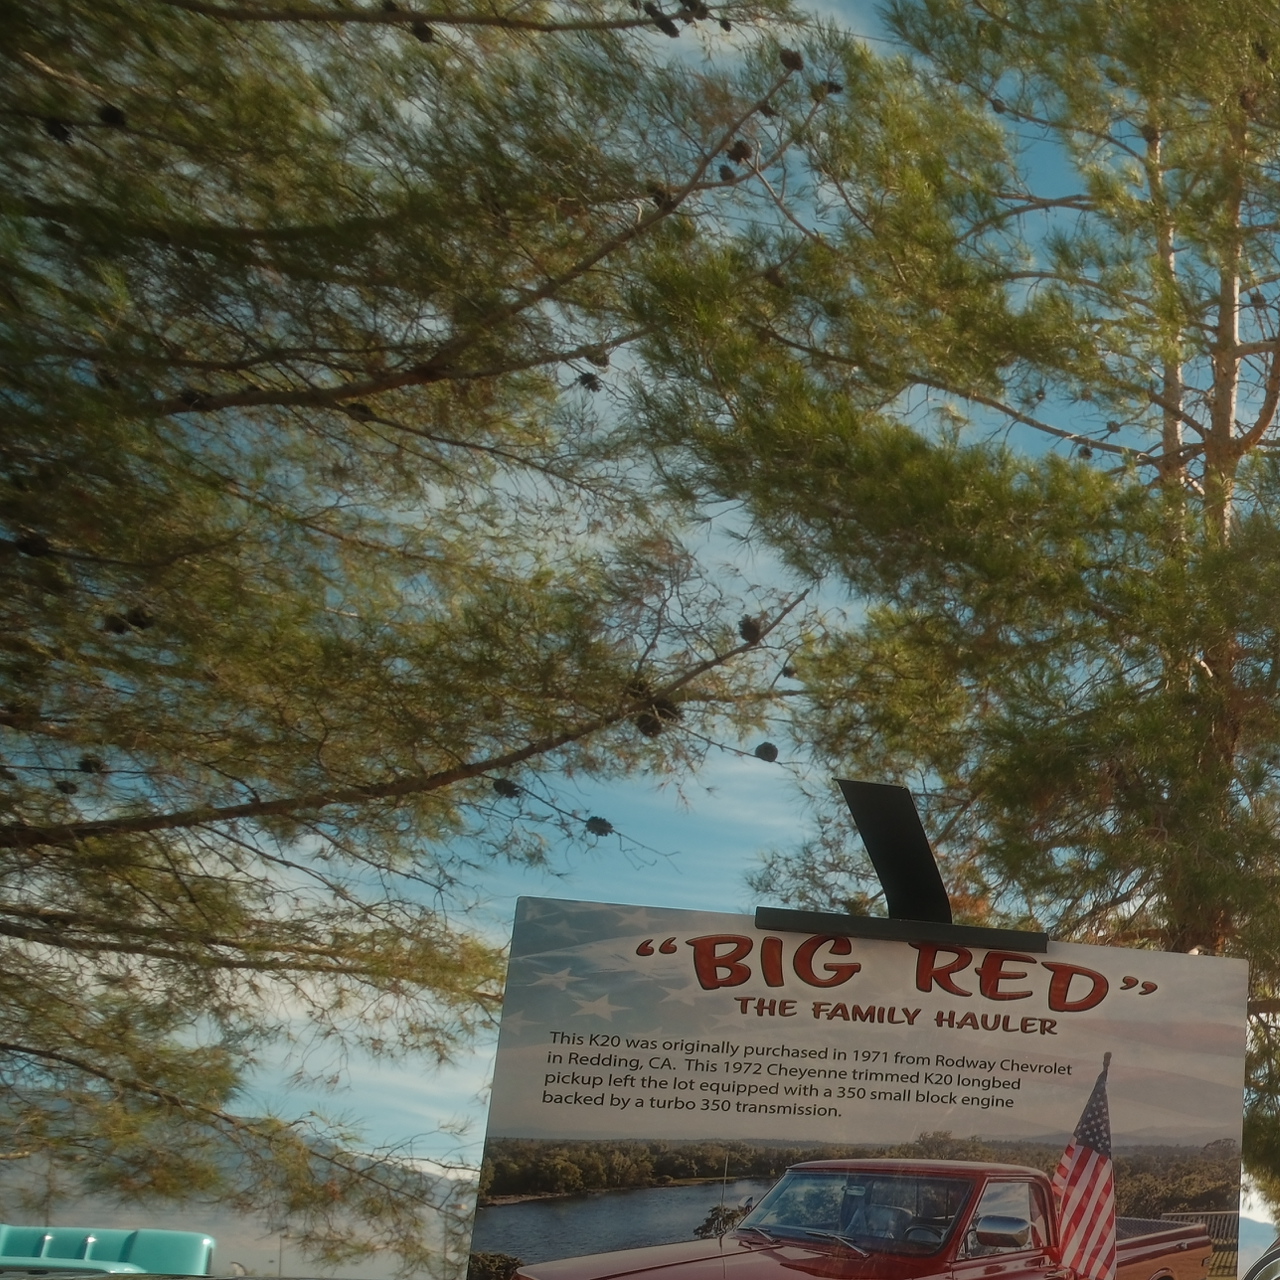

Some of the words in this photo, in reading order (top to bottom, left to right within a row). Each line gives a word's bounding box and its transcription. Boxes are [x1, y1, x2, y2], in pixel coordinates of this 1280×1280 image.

[734, 996, 797, 1017] THE
[812, 1001, 921, 1025] FAMILY
[934, 1010, 1058, 1035] HAULER
[546, 1050, 564, 1064] in
[568, 1052, 644, 1072] Redding,
[648, 1056, 676, 1070] CA.
[684, 1058, 718, 1072] This
[724, 1061, 762, 1075] 1972
[766, 1063, 848, 1080] Cheyenne
[852, 1068, 920, 1084] trimmed
[924, 1072, 953, 1086] K20
[956, 1074, 1021, 1091] longbed
[550, 1031, 584, 1046] This
[589, 1034, 621, 1048] K20
[626, 1038, 658, 1050] was
[662, 1039, 740, 1058] originally
[744, 1044, 828, 1060] purchased
[832, 1048, 847, 1061] in
[853, 1050, 888, 1063] 1971
[894, 1051, 930, 1066] from
[935, 1054, 996, 1073] Rodway
[1000, 1059, 1072, 1076] Chevrolet
[542, 1090, 605, 1106] backed
[610, 1093, 632, 1110] by
[634, 1098, 644, 1108] a
[649, 1096, 696, 1110] turbo
[700, 1098, 731, 1112] 350
[735, 1101, 842, 1117] transmission.
[544, 1072, 604, 1089] pickup
[608, 1074, 636, 1088] left
[640, 1076, 668, 1090] the
[673, 1077, 696, 1091] lot
[699, 1080, 780, 1097] equipped
[784, 1084, 819, 1097] with
[823, 1088, 832, 1098] a
[836, 1086, 866, 1100] 350
[870, 1088, 911, 1102] small
[916, 1090, 958, 1104] block
[961, 1094, 1014, 1110] engine
